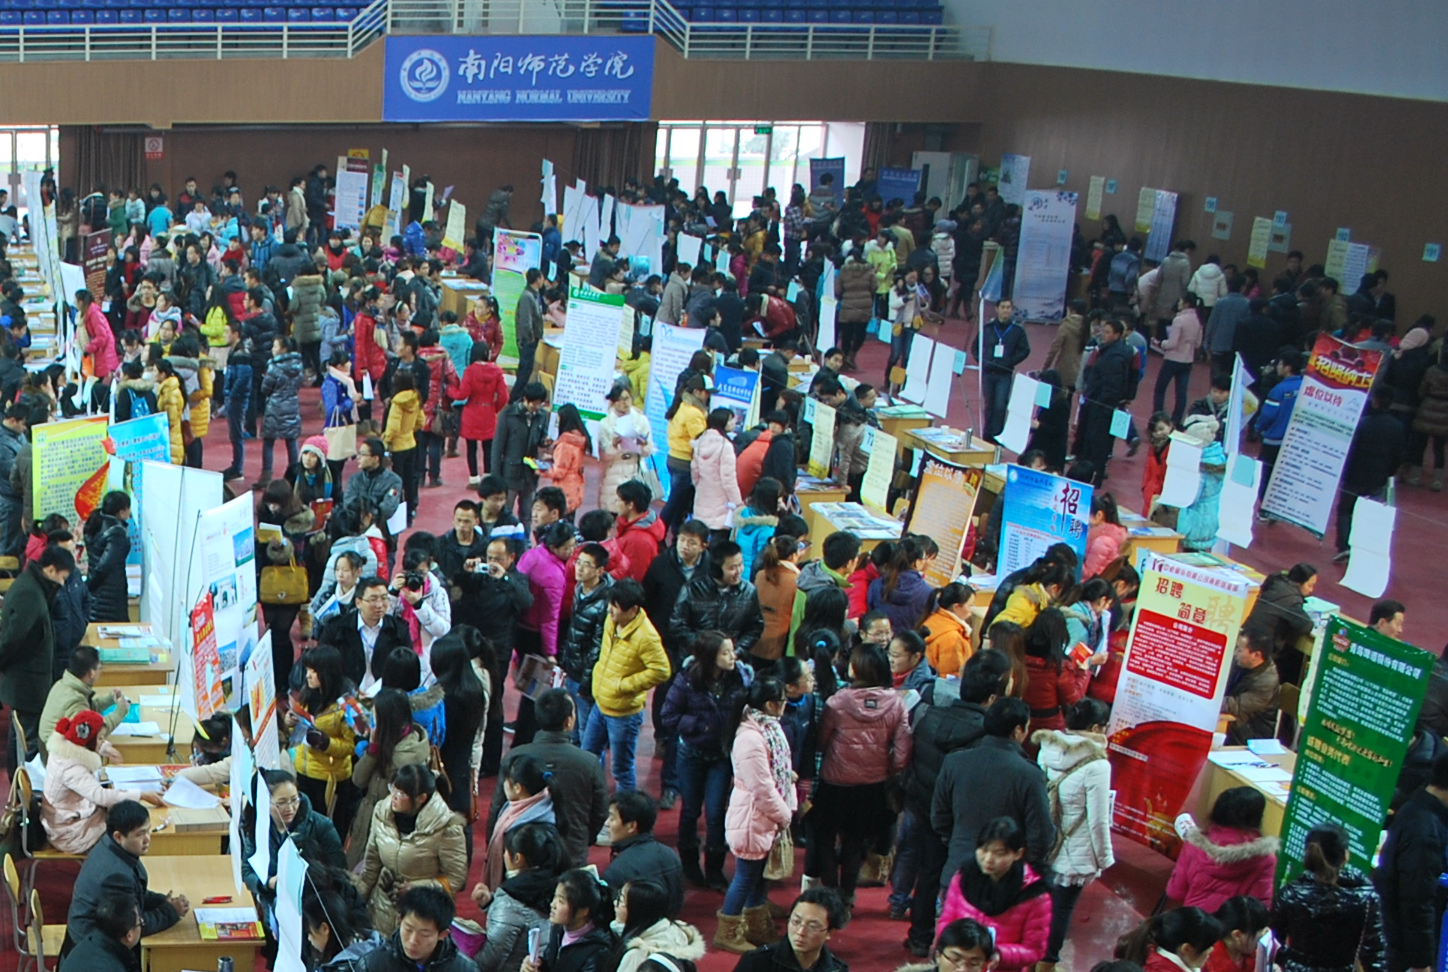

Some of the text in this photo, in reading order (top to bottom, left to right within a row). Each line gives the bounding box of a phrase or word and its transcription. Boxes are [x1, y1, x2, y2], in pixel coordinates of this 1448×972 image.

[457, 49, 634, 87] 南阳师范学院
[457, 89, 631, 105] NANYANG NORMAL UNIVERSITY
[1303, 385, 1343, 408] 虚位以待
[1155, 577, 1184, 599] 招聘
[1177, 602, 1207, 625] 简章
